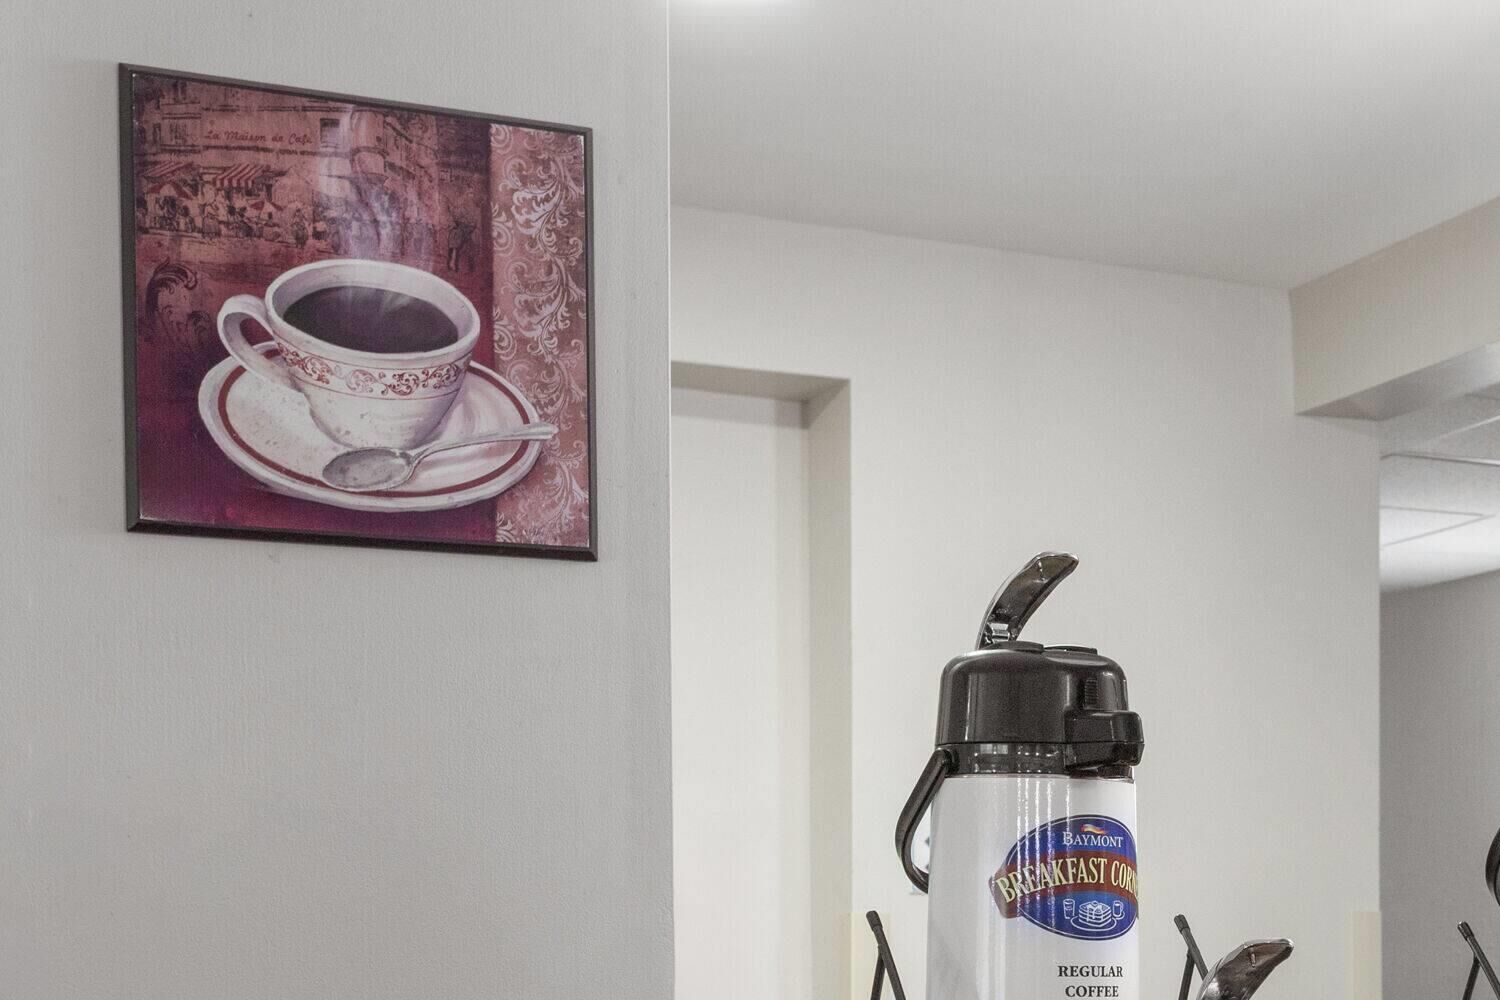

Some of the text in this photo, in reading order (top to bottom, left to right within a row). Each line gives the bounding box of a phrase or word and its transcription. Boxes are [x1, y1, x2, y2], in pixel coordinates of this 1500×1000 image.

[1063, 831, 1123, 848] BAYMONT
[995, 857, 1137, 903] BREAKFAST CORN
[1058, 965, 1123, 978] REGULAR
[1065, 985, 1120, 998] COFFEE
